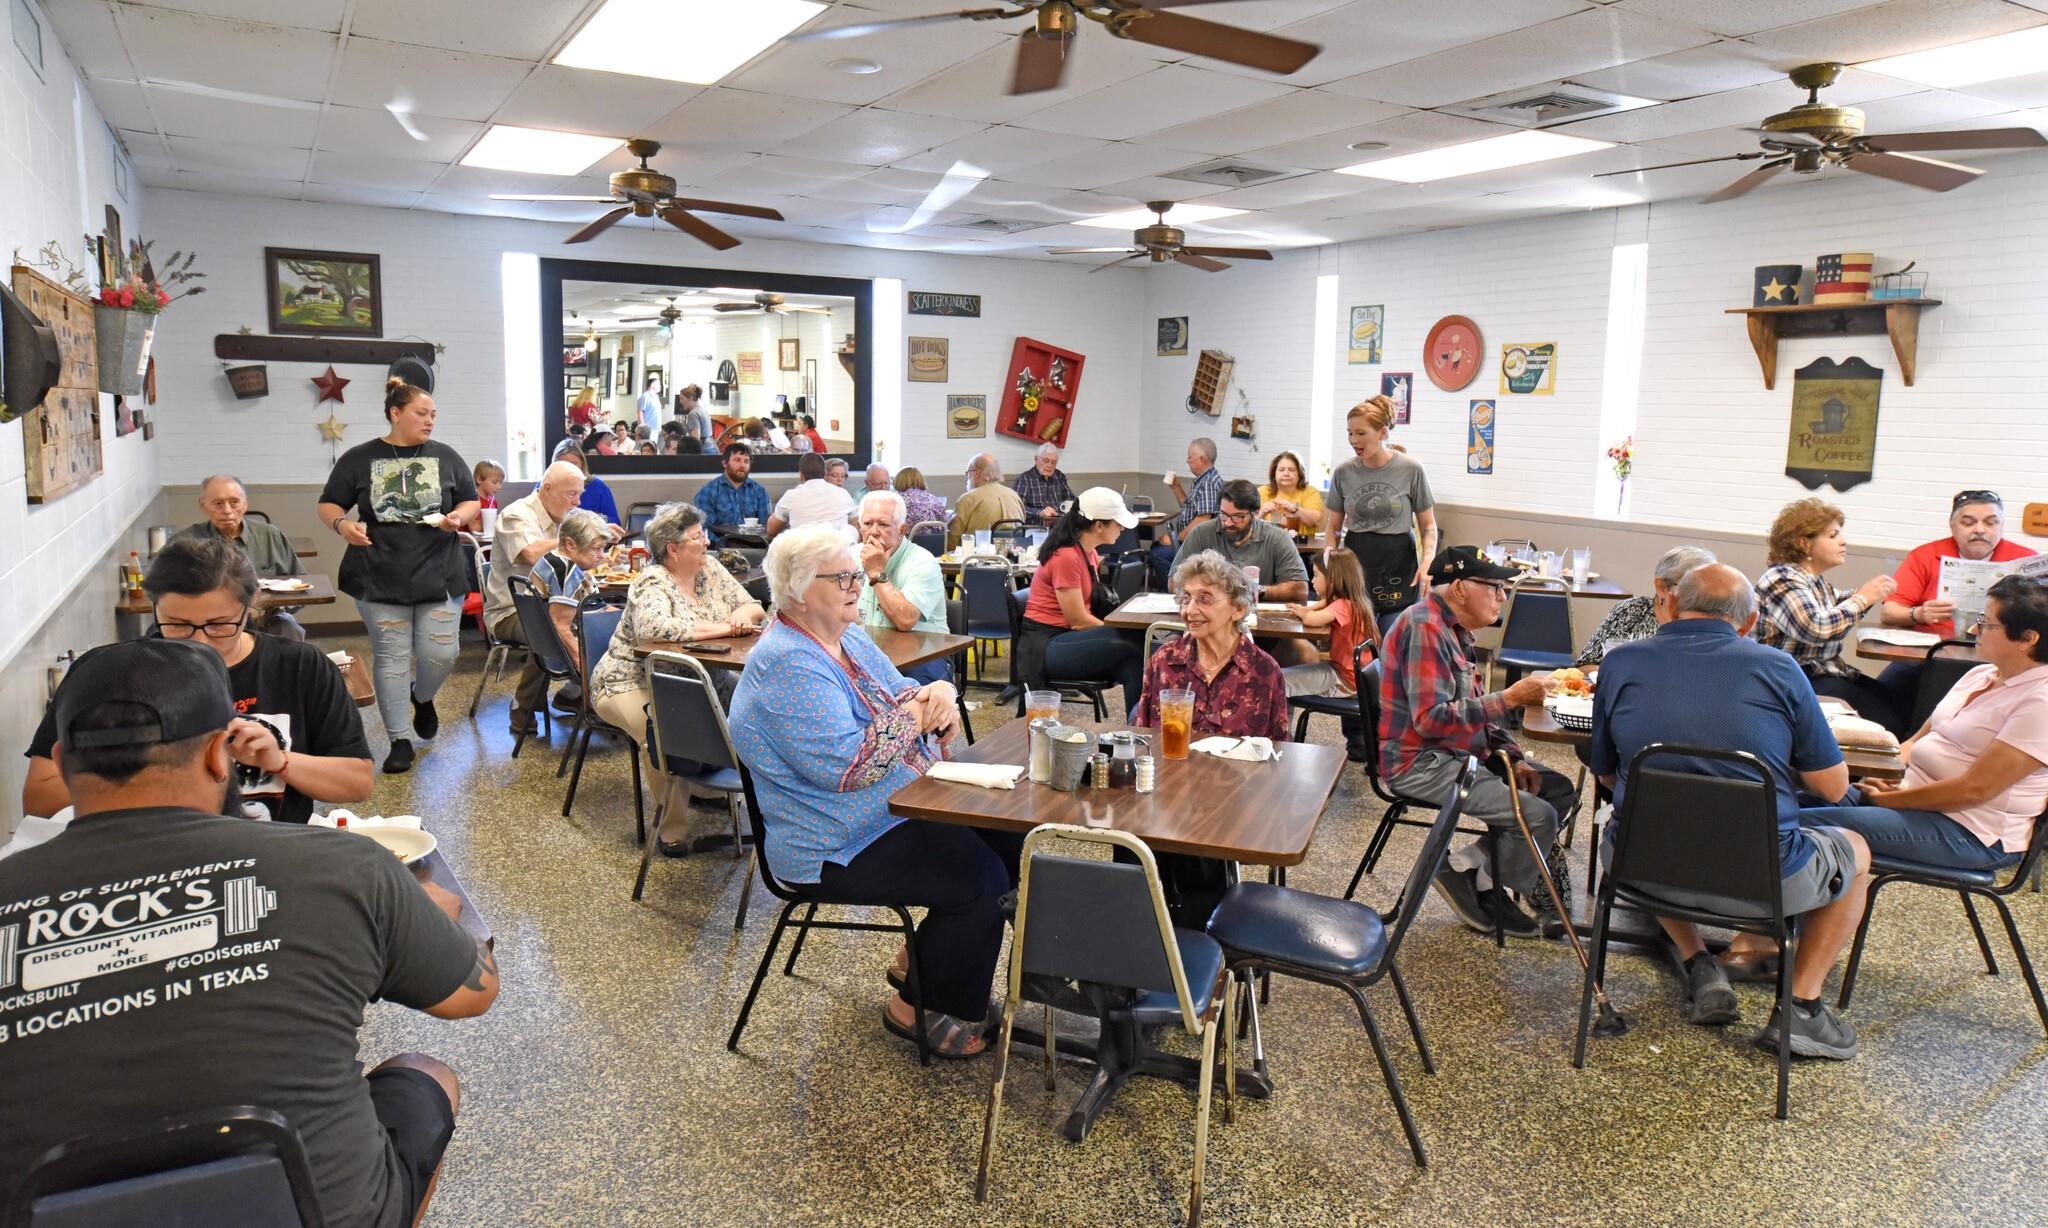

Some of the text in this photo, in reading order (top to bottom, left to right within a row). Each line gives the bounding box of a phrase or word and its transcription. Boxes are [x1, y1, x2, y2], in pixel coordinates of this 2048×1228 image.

[911, 340, 946, 356] HOT DOGS
[59, 887, 93, 902] OF
[98, 858, 257, 895] SUPPLEMENTS
[27, 878, 217, 946] ROCK'S
[31, 917, 213, 965] DISCOUNT VITAMINS
[164, 938, 281, 973] #GODISGREAT
[97, 953, 149, 973] MORE
[0, 982, 81, 1013] CKSBUILT
[16, 989, 157, 1038] LOCATIONS
[165, 979, 192, 1001] IN
[199, 963, 270, 992] TEXAS
